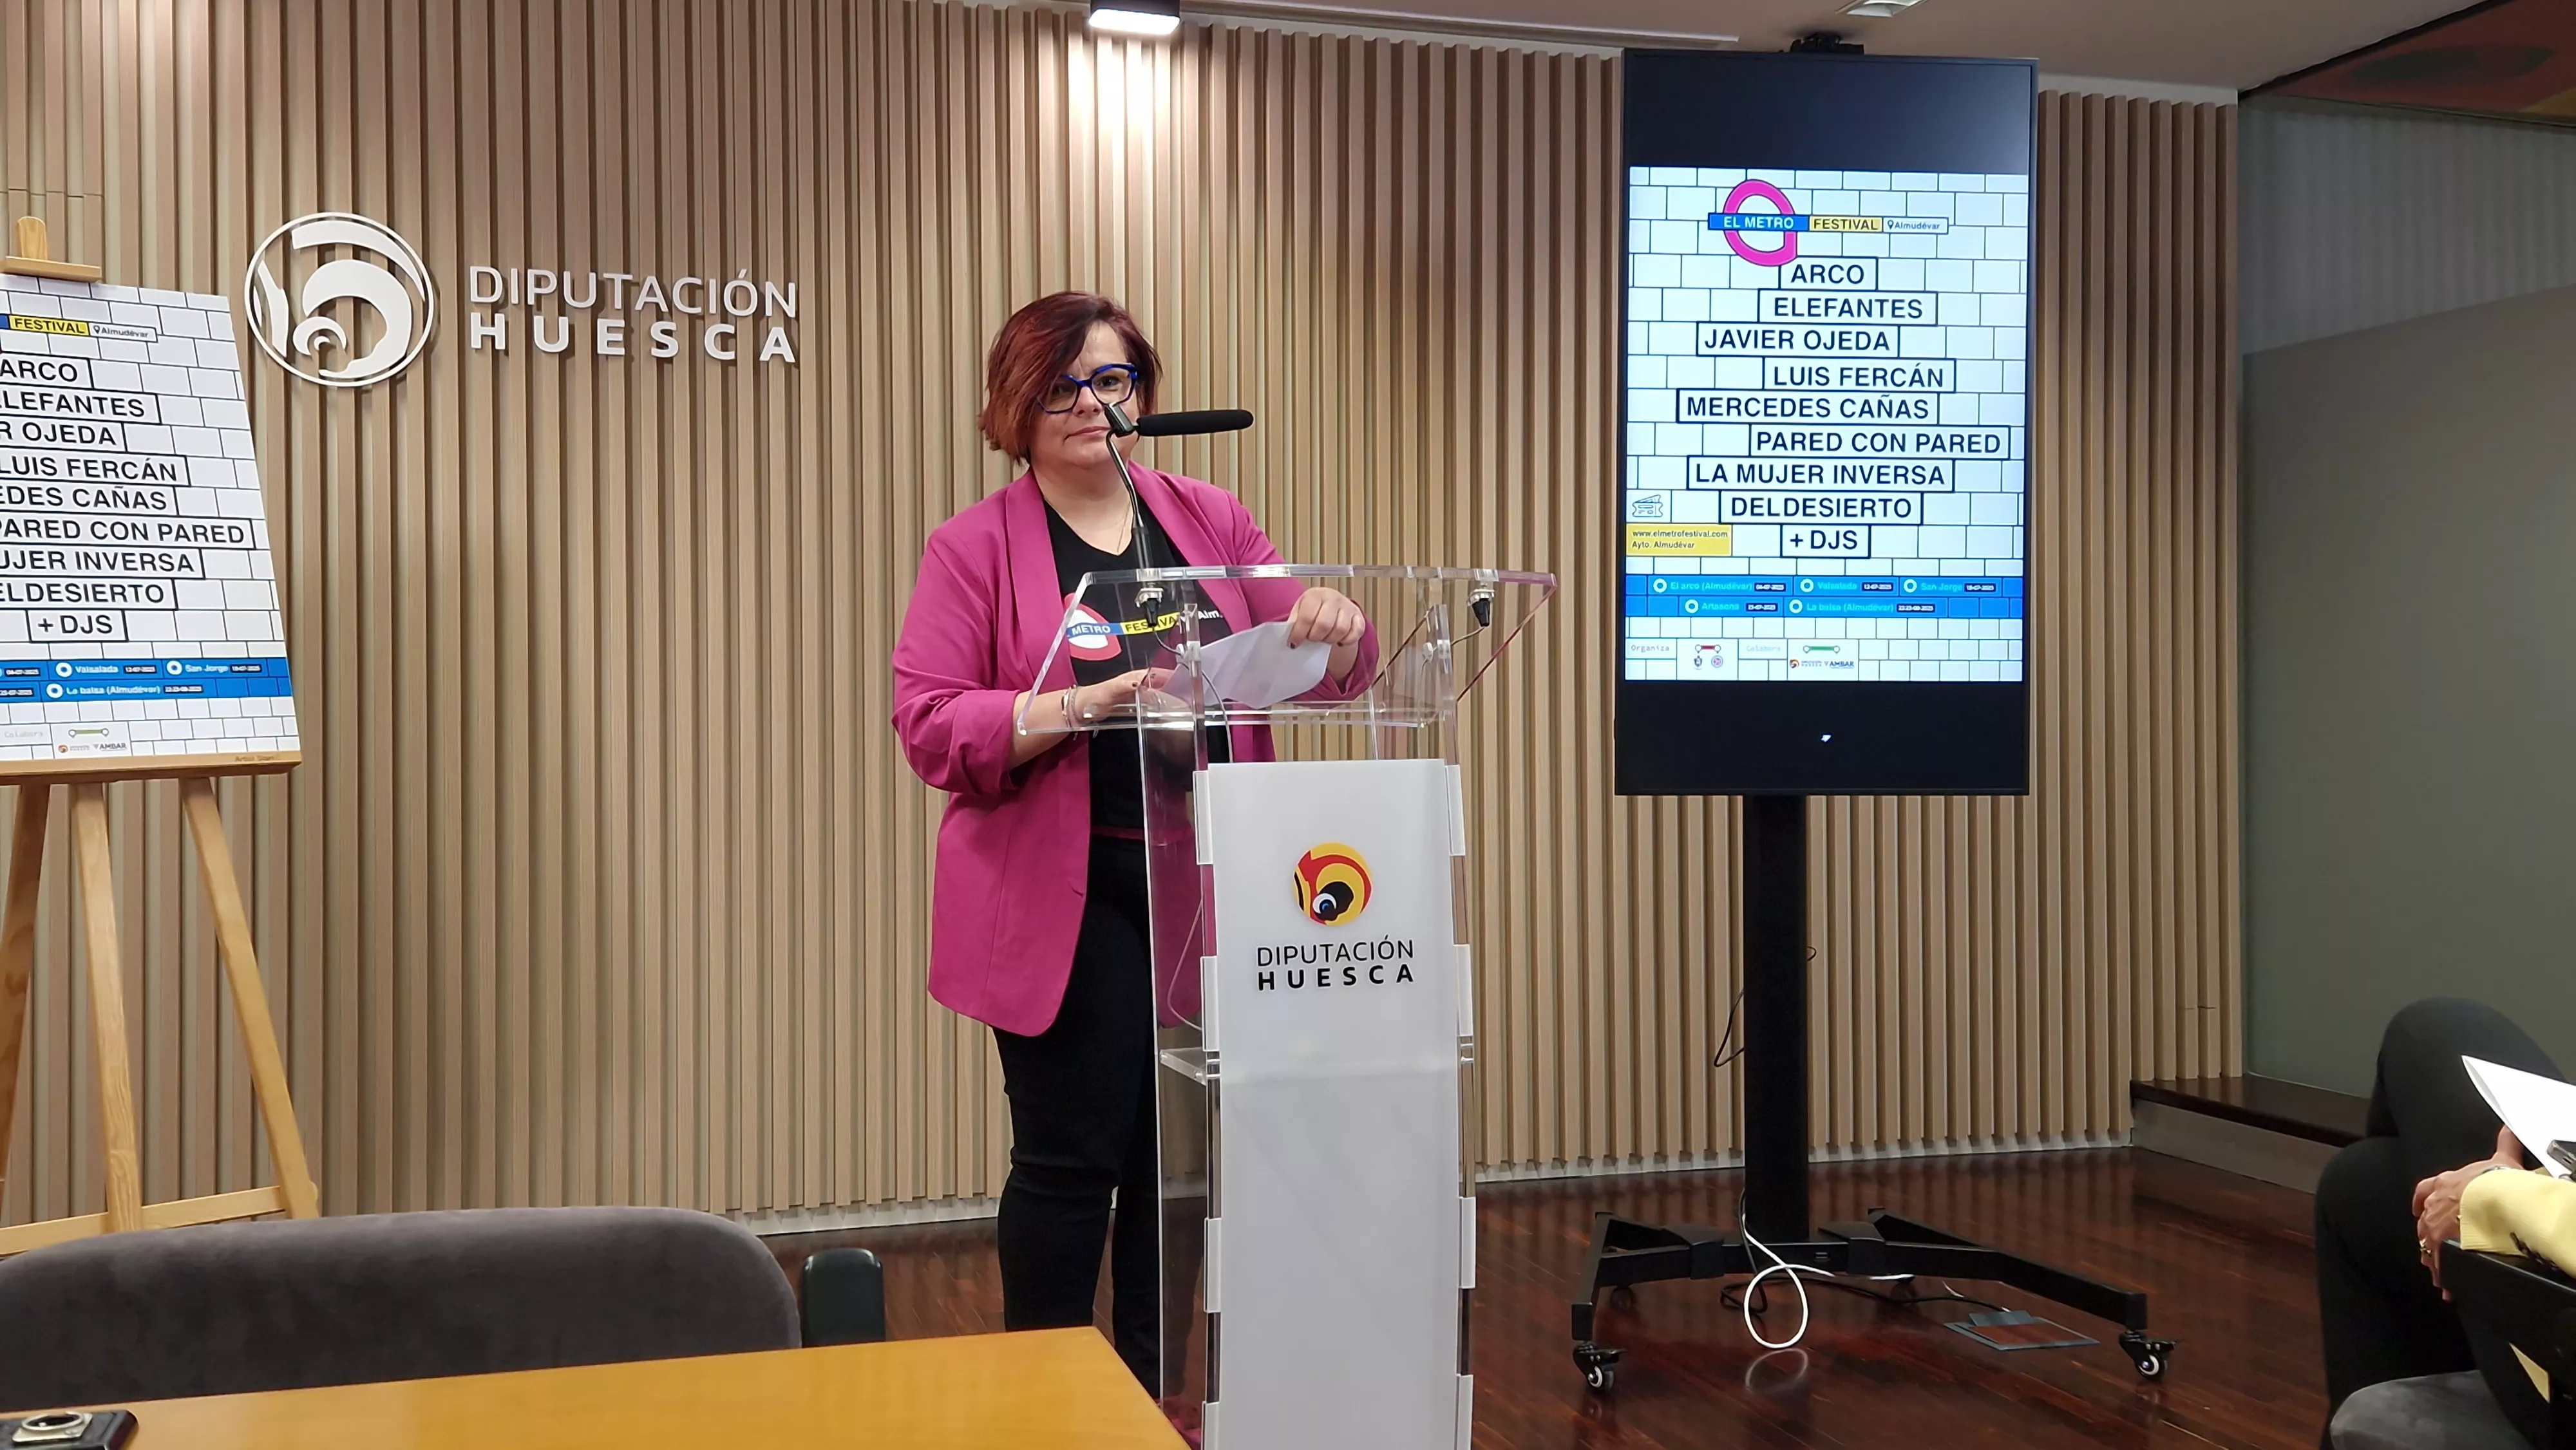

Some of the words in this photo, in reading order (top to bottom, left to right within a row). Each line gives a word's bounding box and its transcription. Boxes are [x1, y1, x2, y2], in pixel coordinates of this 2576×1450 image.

[1724, 217, 1740, 229] EL
[1745, 217, 1794, 229] METRO
[1814, 218, 1878, 231] FESTIVAL
[1895, 222, 1940, 231] Almudévar
[1791, 265, 1864, 284] ARCO
[469, 265, 796, 318] DIPUTACIÓN
[1774, 297, 1923, 319] ELEFANTES
[14, 317, 86, 335] FESTIVAL
[101, 327, 148, 338] Almudévar
[471, 312, 796, 363] HUESCA
[1705, 329, 1794, 349] JAVIER
[1804, 331, 1889, 351] OJEDA
[0, 359, 77, 382] ARCO
[1774, 366, 1830, 386] LUIS
[1840, 363, 1944, 388] FERCÁN
[0, 390, 145, 417] LEFANTES
[1687, 397, 1830, 418] MERCEDES
[1840, 394, 1929, 419] CAÑAS
[23, 422, 116, 446] OJEDA
[1757, 432, 1842, 451] PARED
[1852, 434, 1906, 453] CON
[1916, 435, 2000, 453] PARED
[67, 458, 176, 481] FERCÁN
[1696, 464, 1728, 483] LA
[1738, 464, 1824, 484] MUJER
[1833, 466, 1945, 485] INVERSA
[72, 486, 167, 510] CAÑAS
[1732, 498, 1911, 518] DELDESIERTO
[0, 518, 80, 538] ARED
[90, 521, 148, 541] CON
[158, 523, 244, 544] PARED
[1790, 536, 1803, 548] +
[1810, 531, 1857, 550] DJS
[75, 552, 194, 572] INVERSA
[1939, 583, 1962, 592] Jorge
[38, 617, 53, 633] +
[61, 615, 113, 634] DJS
[1072, 625, 1110, 636] METRO
[1631, 644, 1670, 653] Organiza
[204, 664, 229, 673] Jorge
[1257, 934, 1414, 966] DIPUTACIÓN
[1258, 964, 1414, 991] HUESCA
